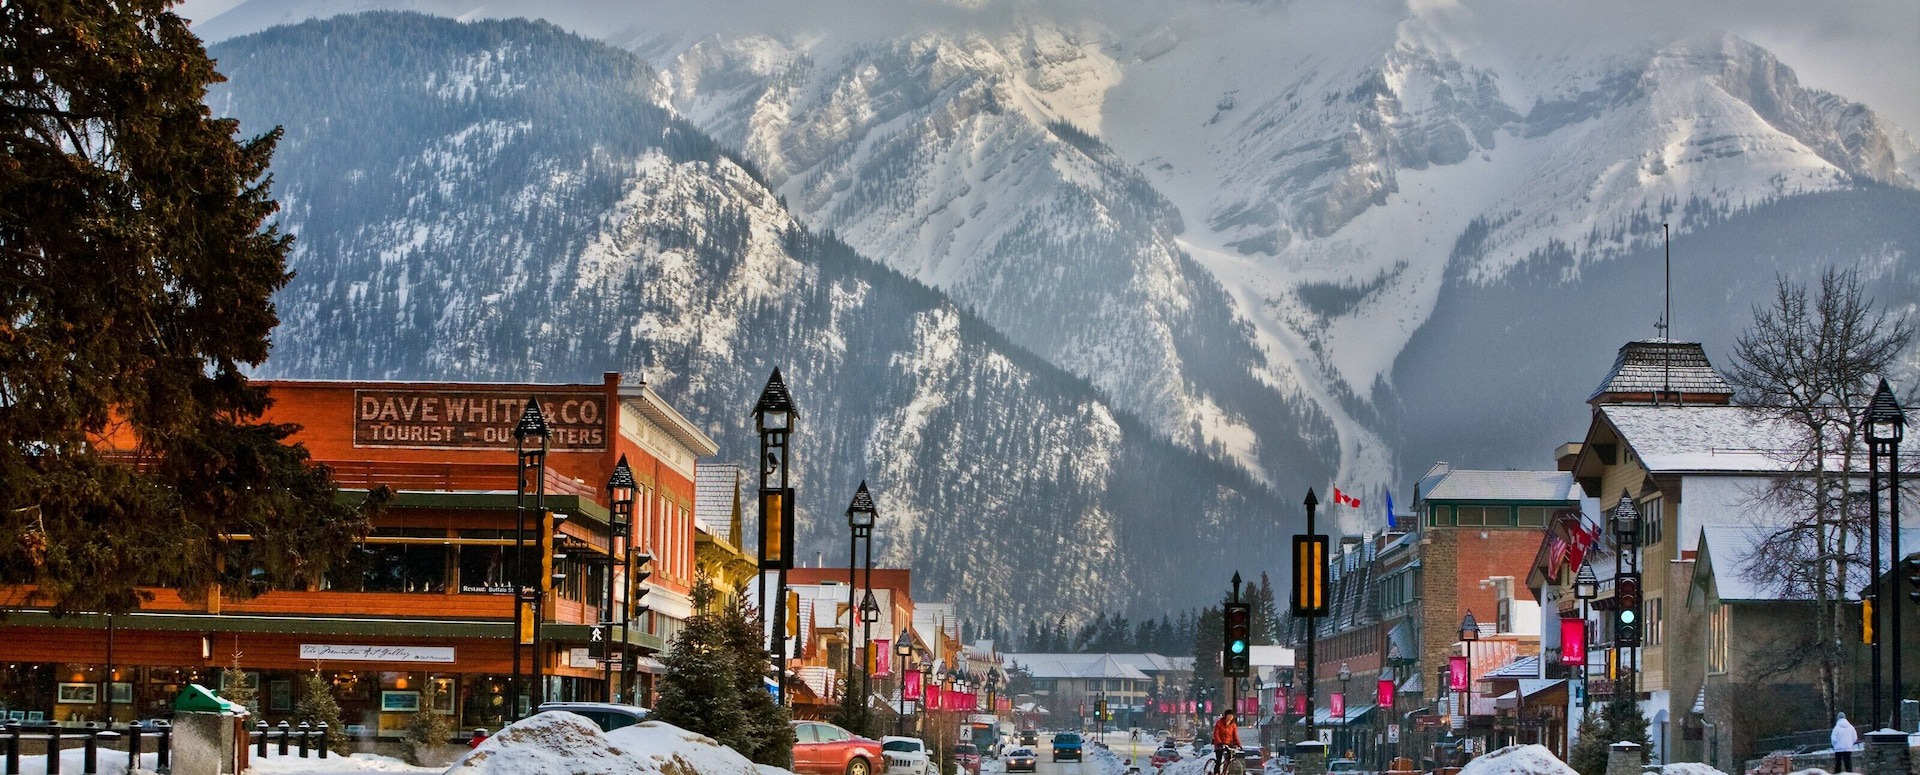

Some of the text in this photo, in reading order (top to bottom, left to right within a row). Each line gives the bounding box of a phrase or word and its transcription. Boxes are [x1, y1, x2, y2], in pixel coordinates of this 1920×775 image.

[361, 396, 439, 421] DAVE
[541, 402, 557, 424] &
[560, 400, 603, 425] CO.
[369, 424, 456, 442] TOURIST
[483, 427, 603, 445] OUTERS
[303, 645, 316, 654] The
[319, 644, 360, 655] Mountain
[378, 647, 410, 660] Gallery
